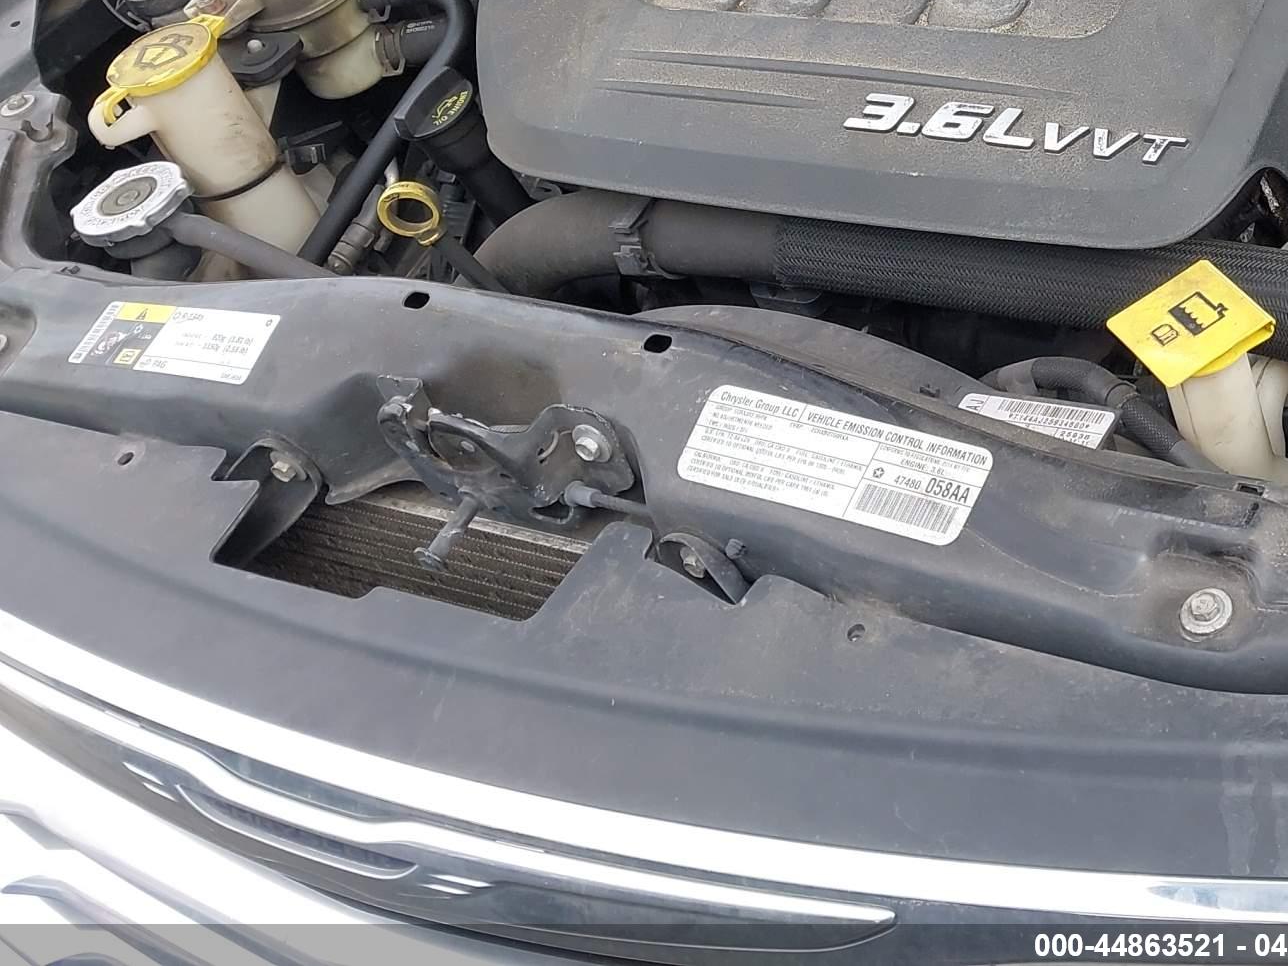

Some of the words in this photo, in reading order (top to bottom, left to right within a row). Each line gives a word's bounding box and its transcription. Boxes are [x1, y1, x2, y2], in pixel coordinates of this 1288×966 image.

[448, 90, 468, 115] ENGINE
[432, 116, 448, 126] OIL
[720, 391, 754, 408] Chrysler
[755, 399, 780, 414] Group
[782, 406, 800, 418] LLC
[966, 398, 986, 412] AJ
[807, 412, 843, 428] VEHICLE
[842, 420, 884, 438] EMISSION
[884, 432, 924, 450] CONTROL
[926, 442, 988, 466] INFORMATION
[900, 458, 929, 472] ENGINE:
[930, 468, 944, 476] 3.6L
[894, 475, 922, 490] 47480
[925, 478, 970, 504] 058AA
